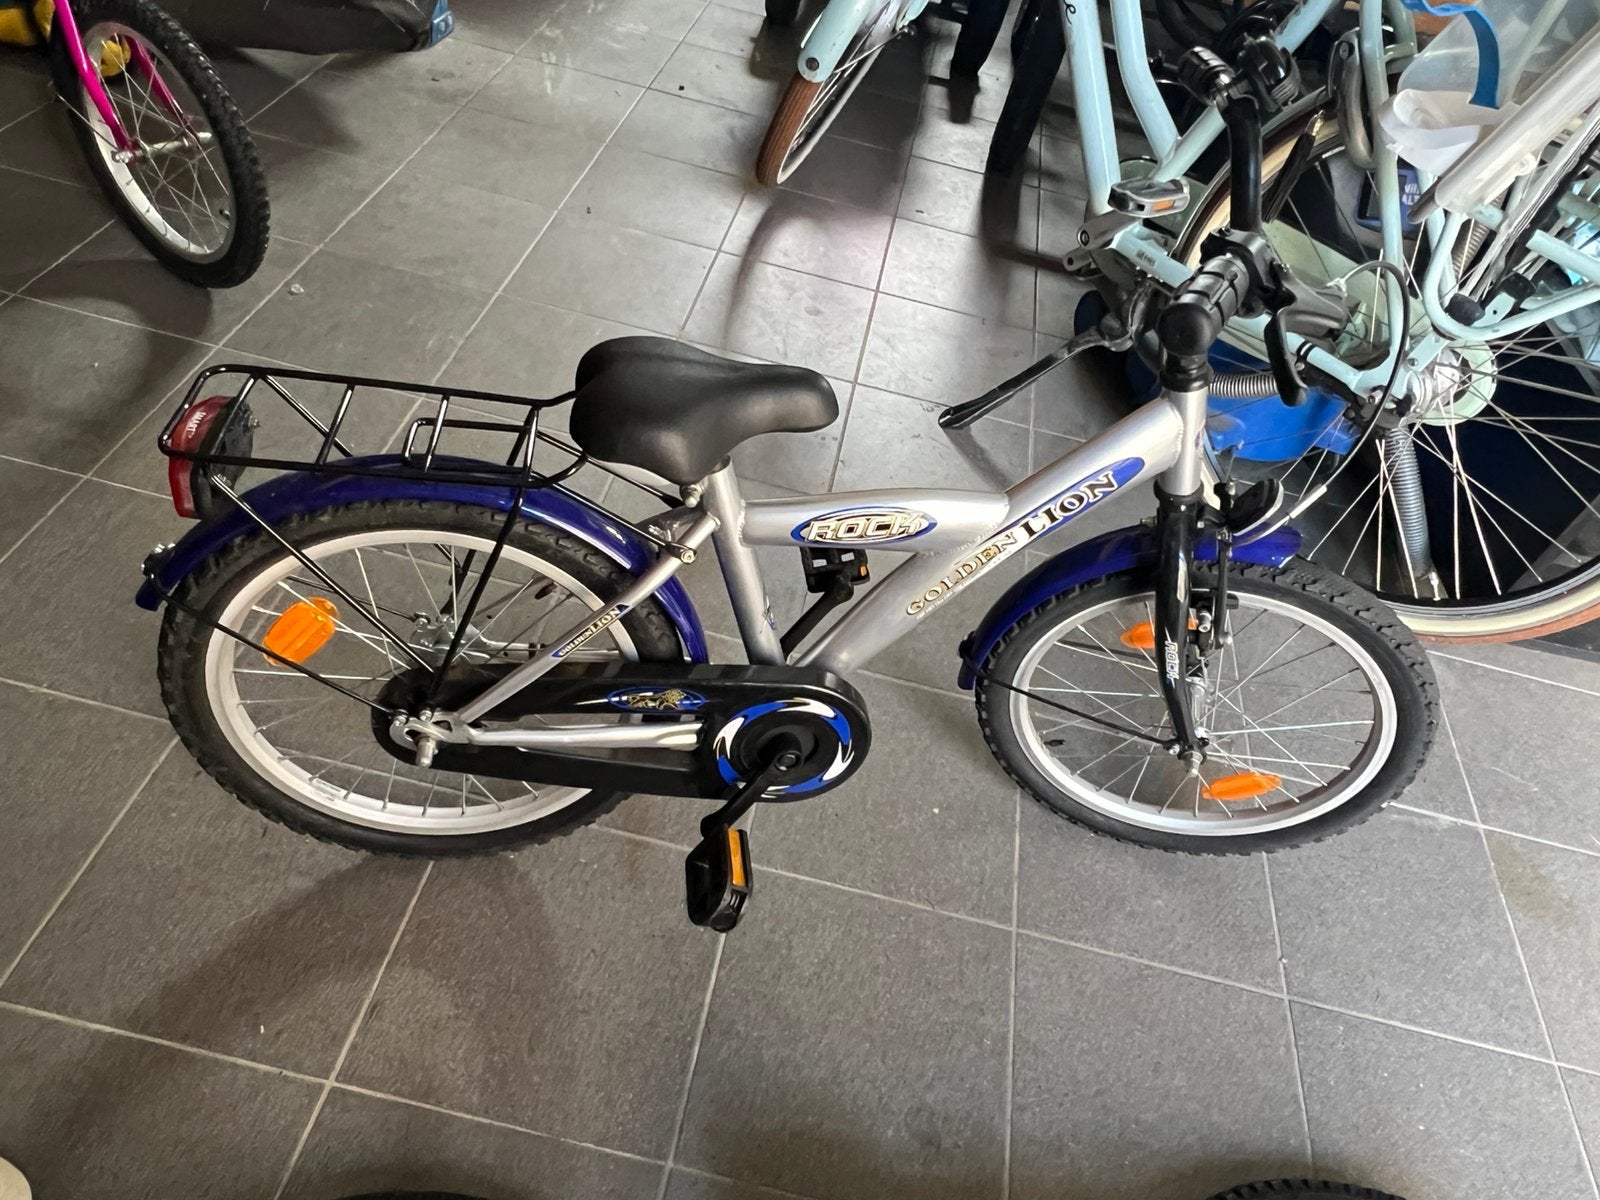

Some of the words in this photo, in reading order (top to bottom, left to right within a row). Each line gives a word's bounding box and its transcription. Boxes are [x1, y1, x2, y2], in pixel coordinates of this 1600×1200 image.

[805, 511, 925, 542] ROCK
[905, 531, 1018, 616] GOLDEN
[1019, 470, 1120, 540] LION
[589, 606, 621, 634] LION
[1164, 640, 1180, 680] ROCK
